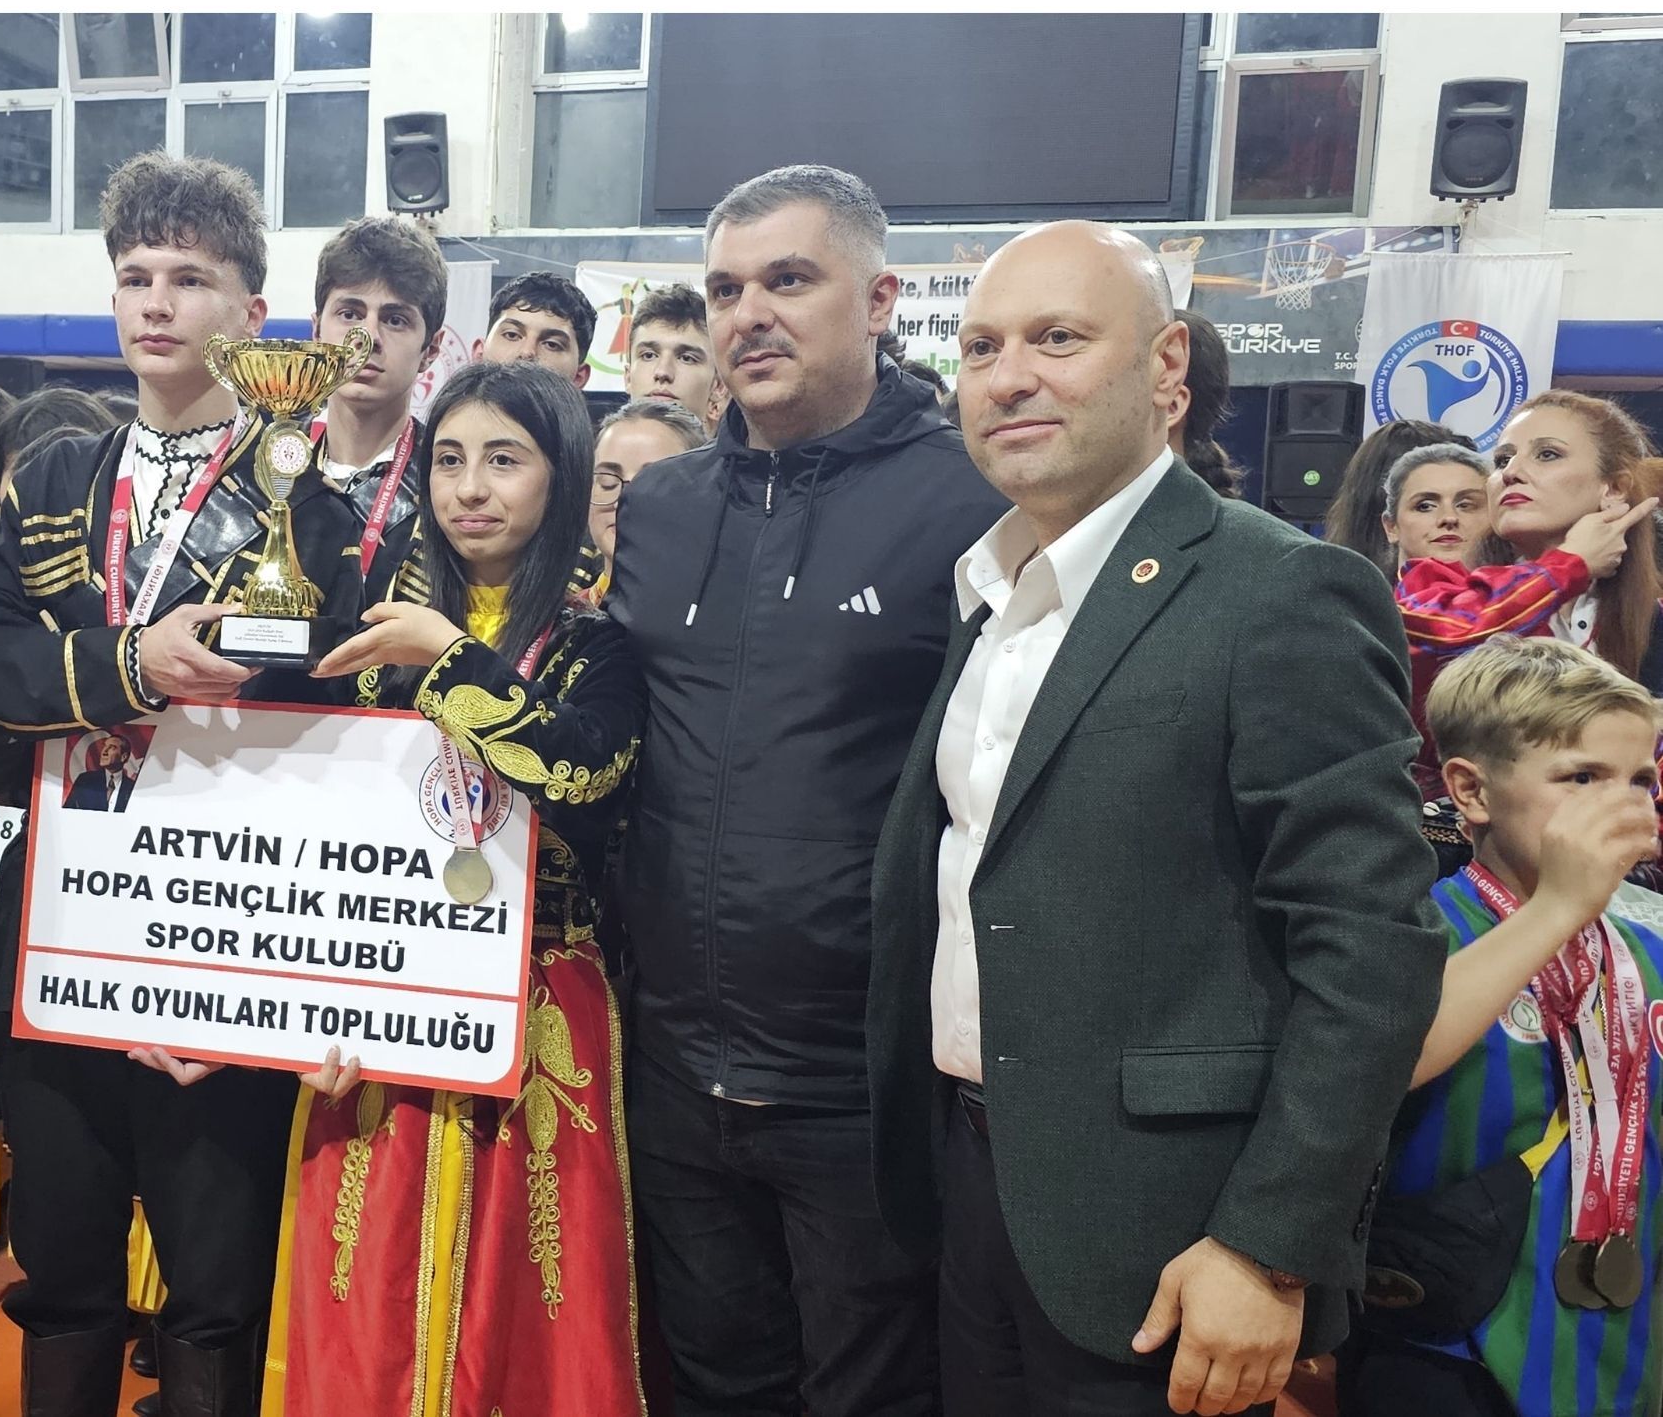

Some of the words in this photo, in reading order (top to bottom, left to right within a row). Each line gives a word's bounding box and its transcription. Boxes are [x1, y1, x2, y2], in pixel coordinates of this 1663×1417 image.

[897, 314, 923, 336] her
[1379, 353, 1398, 377] FOLK
[1435, 344, 1475, 356] THOF
[1510, 358, 1524, 383] HALK
[1375, 378, 1386, 410] DANCE
[373, 494, 390, 524] TÜRKİYE
[109, 529, 123, 565] TÜRKİYE
[108, 566, 121, 626] CUMHURİYE
[130, 825, 282, 867] ARTVİN
[294, 838, 307, 869] /
[320, 839, 435, 880] HOPA
[61, 867, 154, 902] HOPA
[166, 877, 326, 918] GENÇLİK
[337, 892, 509, 936] MERKEZİ
[1477, 879, 1516, 916] GENÇLİK
[145, 922, 240, 956] SPOR
[252, 931, 406, 973] KULUBÜ
[39, 975, 122, 1012] HALK
[131, 984, 289, 1031] OYUNLARI
[300, 1002, 496, 1054] TOPLULUĞU
[1624, 1101, 1639, 1154] GENÇLİK
